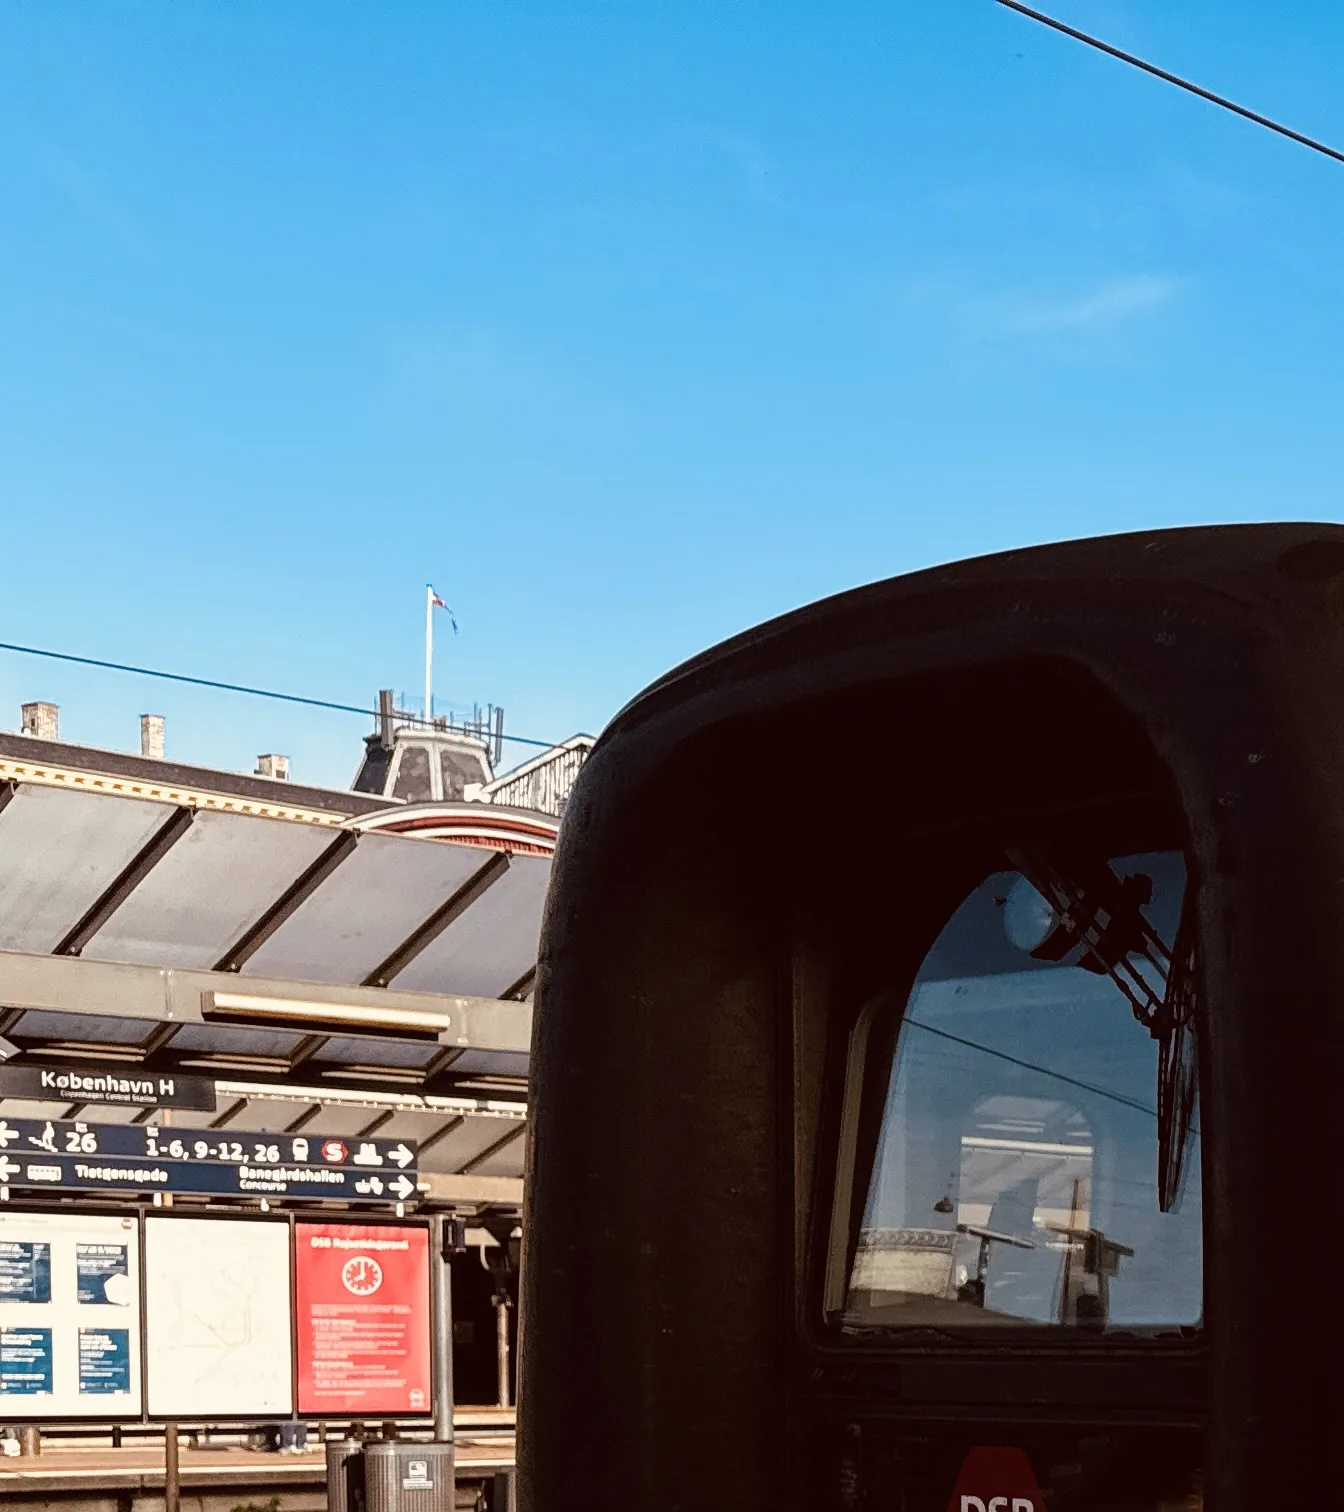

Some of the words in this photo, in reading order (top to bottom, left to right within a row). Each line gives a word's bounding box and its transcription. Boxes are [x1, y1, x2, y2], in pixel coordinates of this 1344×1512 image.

[41, 1071, 154, 1094] København
[159, 1079, 175, 1096] H
[66, 1132, 97, 1153] 26
[146, 1138, 190, 1160] 1-6,
[194, 1141, 249, 1163] 9-12,
[254, 1144, 280, 1162] 26
[75, 1164, 168, 1183] Tietgensgade
[239, 1180, 288, 1191] Concourse
